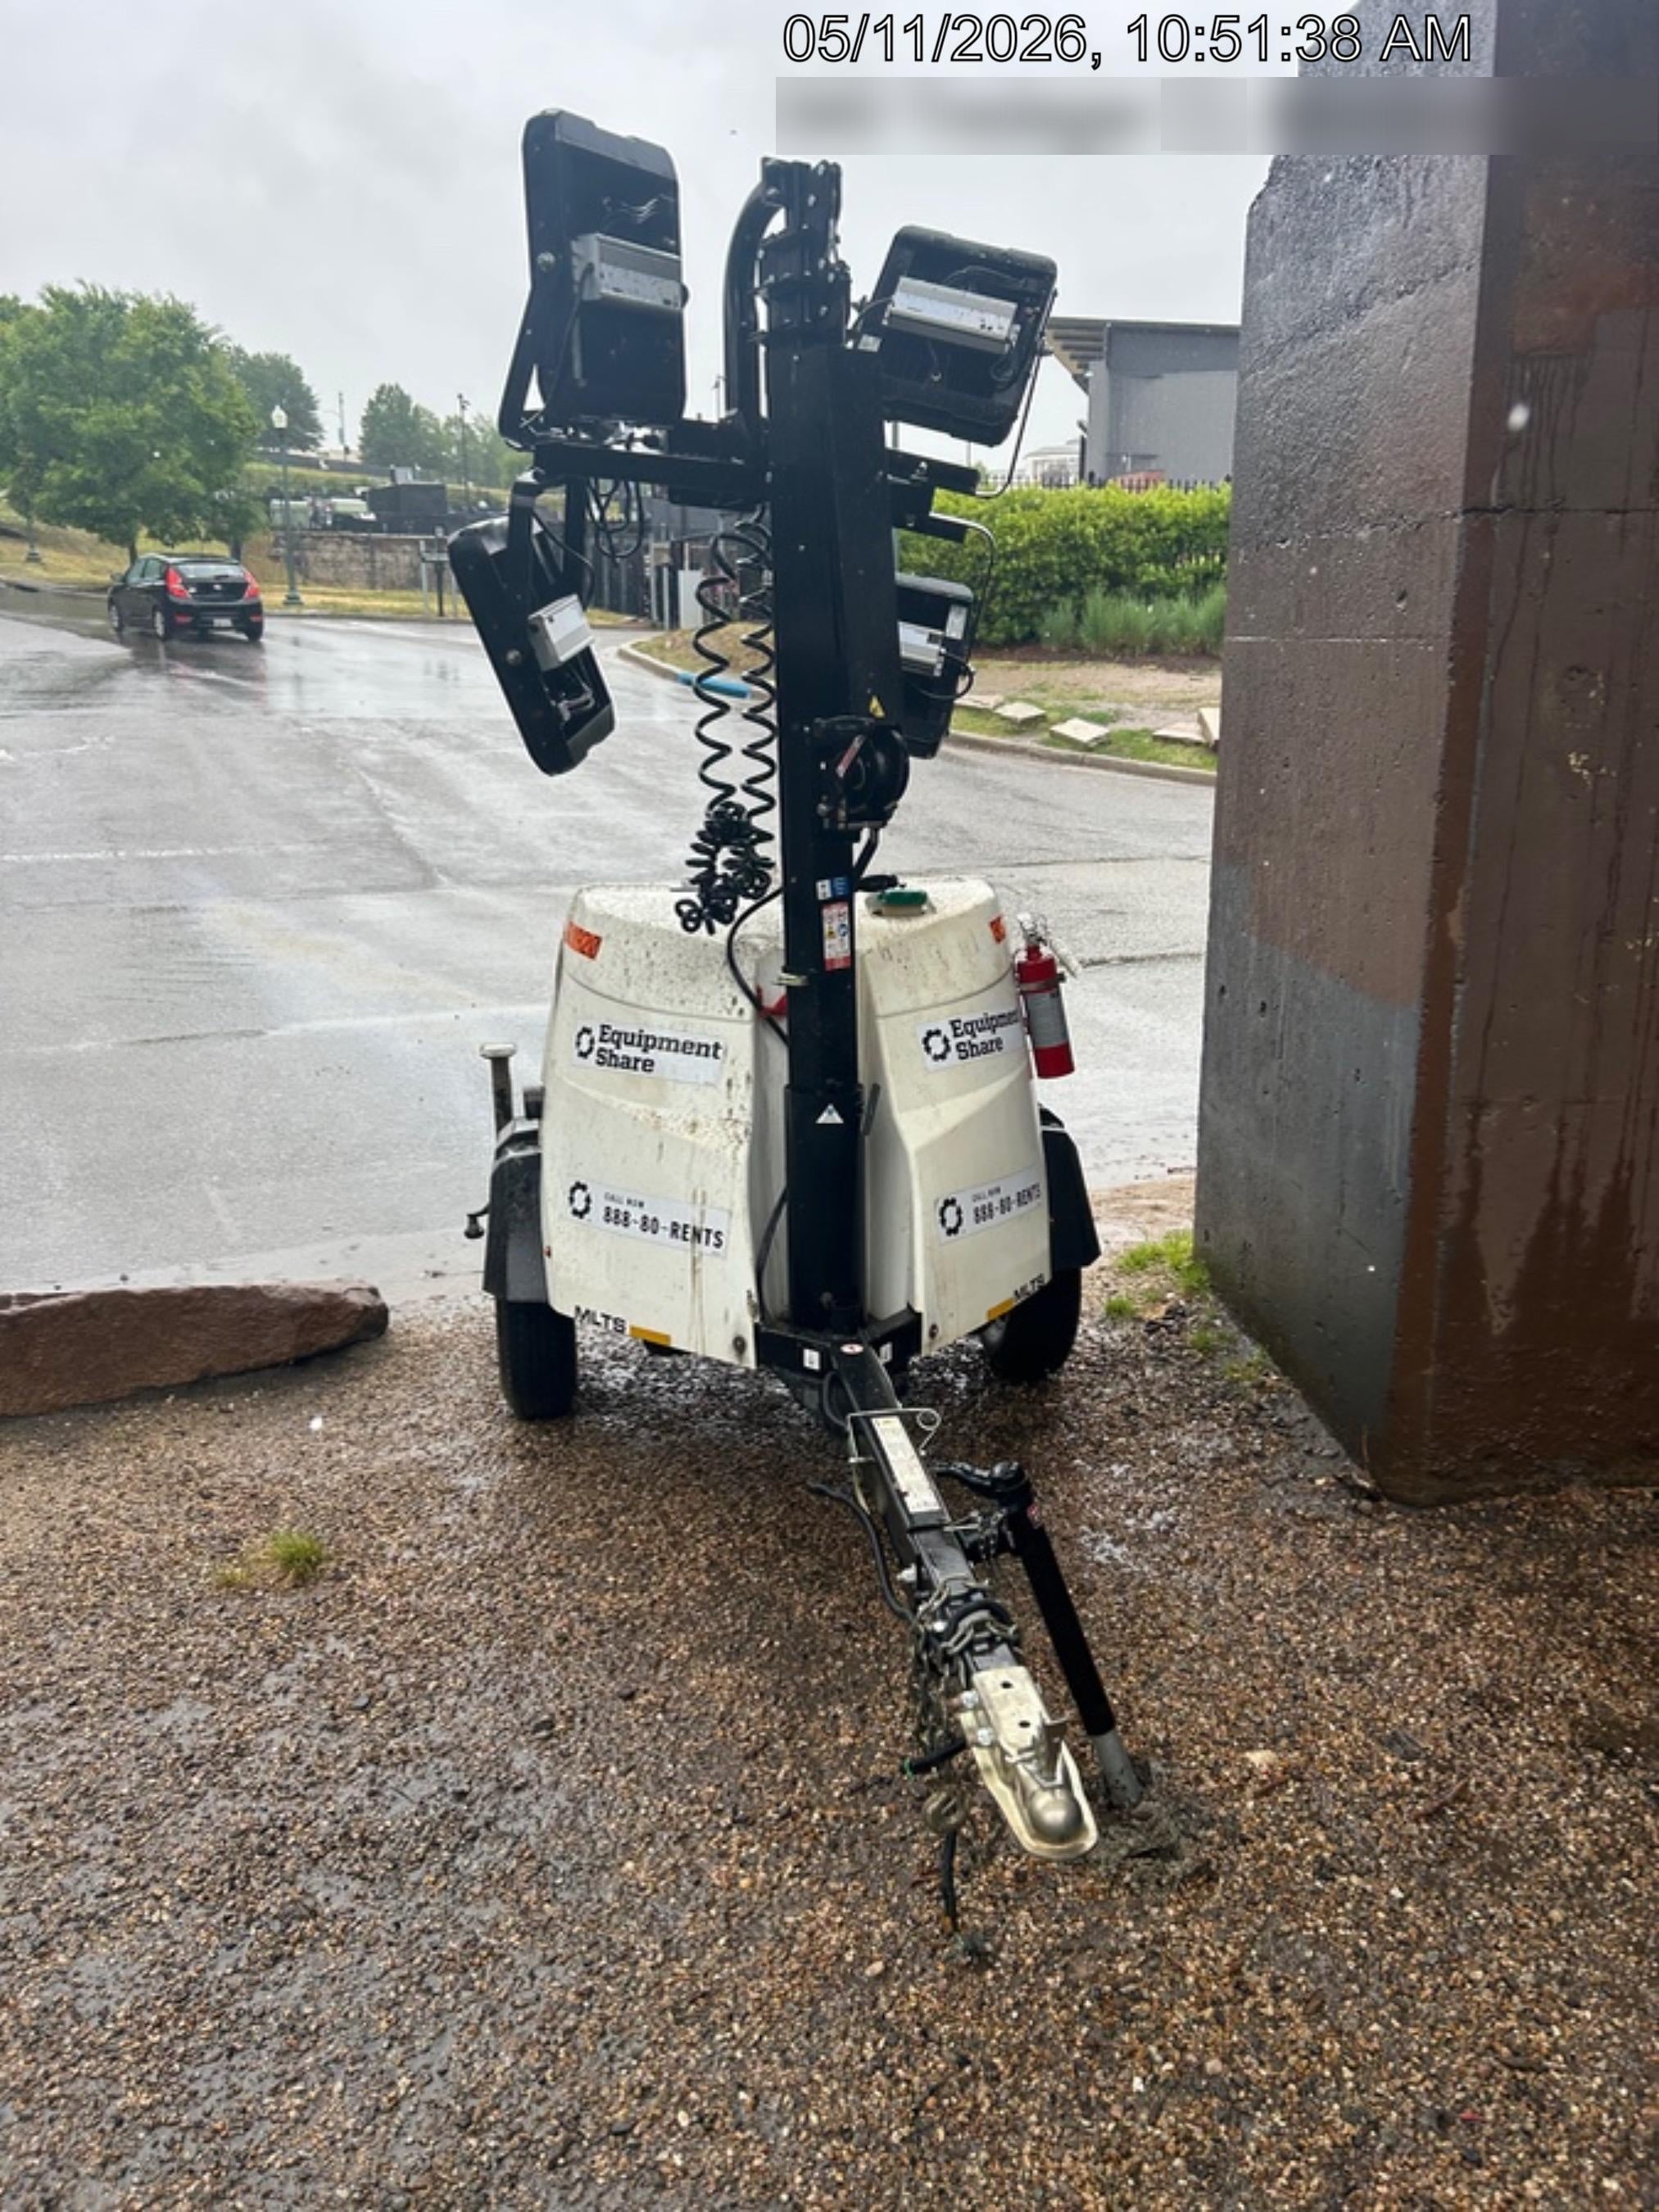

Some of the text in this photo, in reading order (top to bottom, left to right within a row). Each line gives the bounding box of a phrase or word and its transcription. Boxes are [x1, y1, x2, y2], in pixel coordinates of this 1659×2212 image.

[599, 1024, 723, 1060] Equipment
[955, 1036, 1004, 1061] Share
[596, 1046, 655, 1073] Share
[603, 1206, 723, 1249] 888-80-RENTS
[574, 1304, 626, 1335] MLTS
